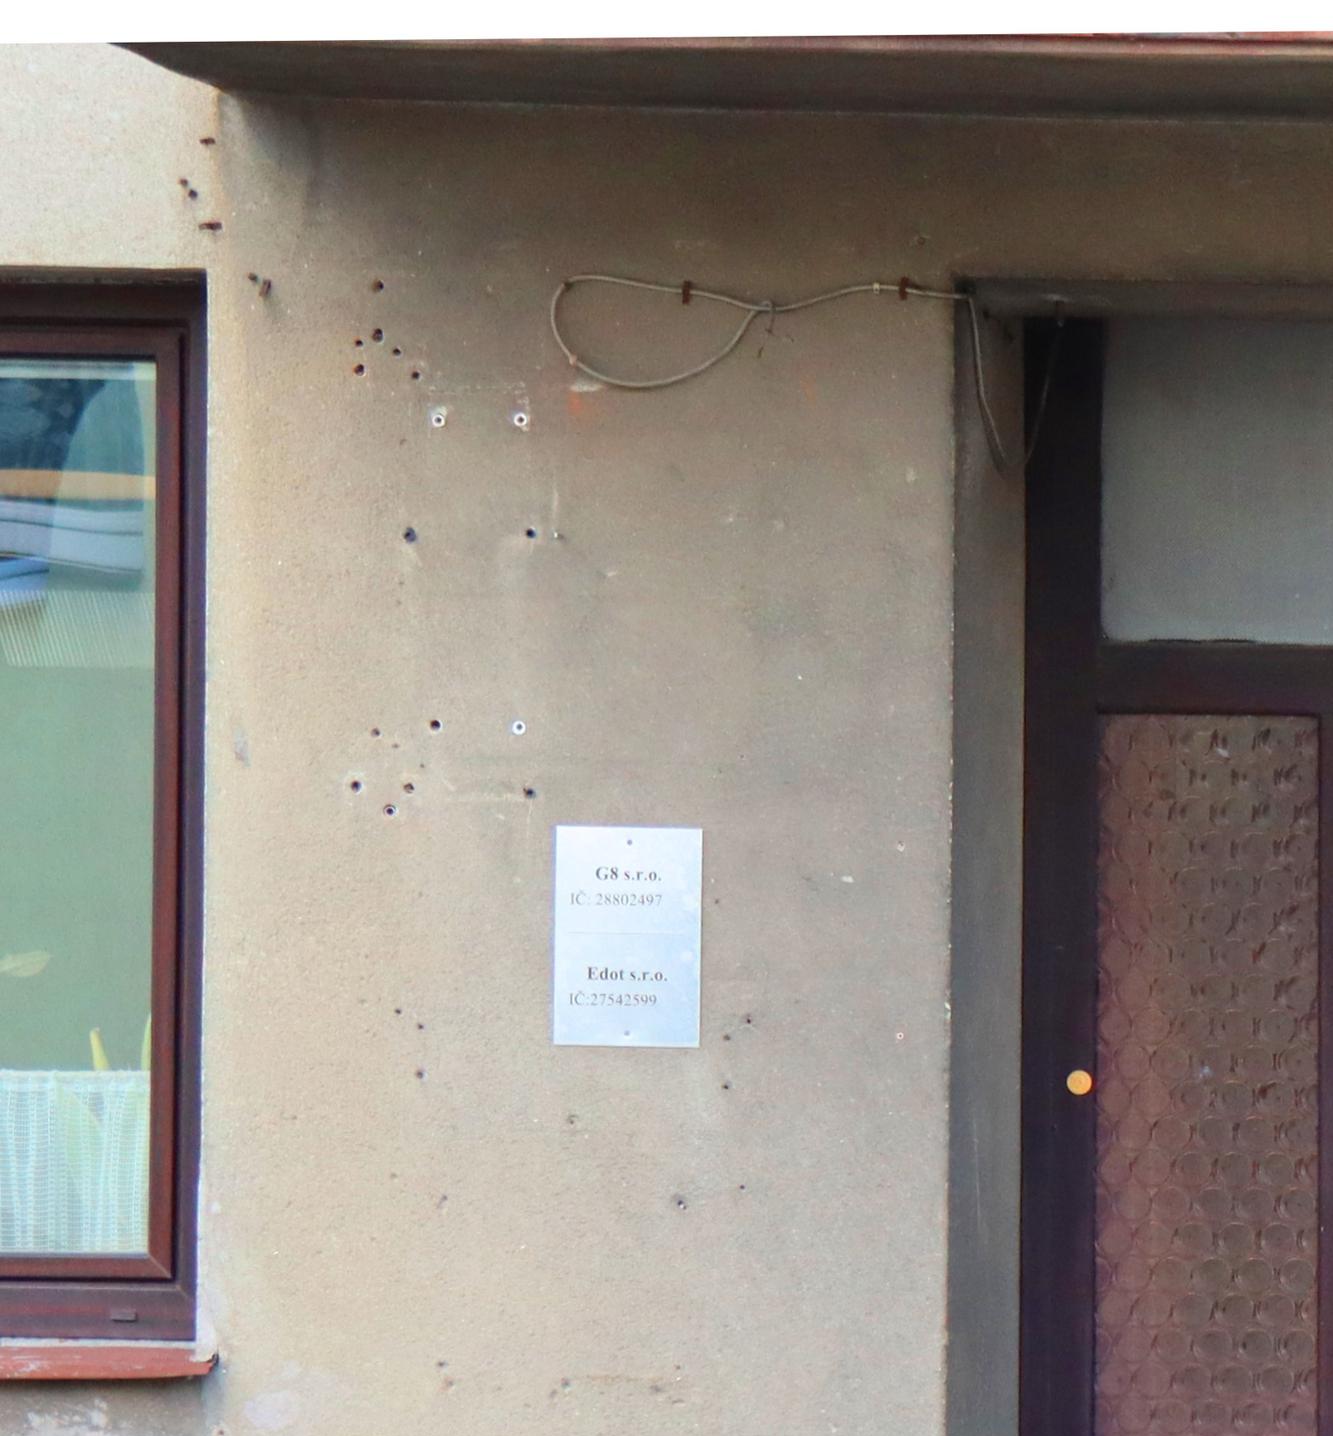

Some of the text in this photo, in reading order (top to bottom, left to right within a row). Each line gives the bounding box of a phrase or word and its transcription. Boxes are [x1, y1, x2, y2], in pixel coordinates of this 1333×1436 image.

[595, 866, 663, 882] G8 s.r.o.
[596, 894, 663, 907] 28802497
[587, 966, 668, 983] Edot s.r.o.
